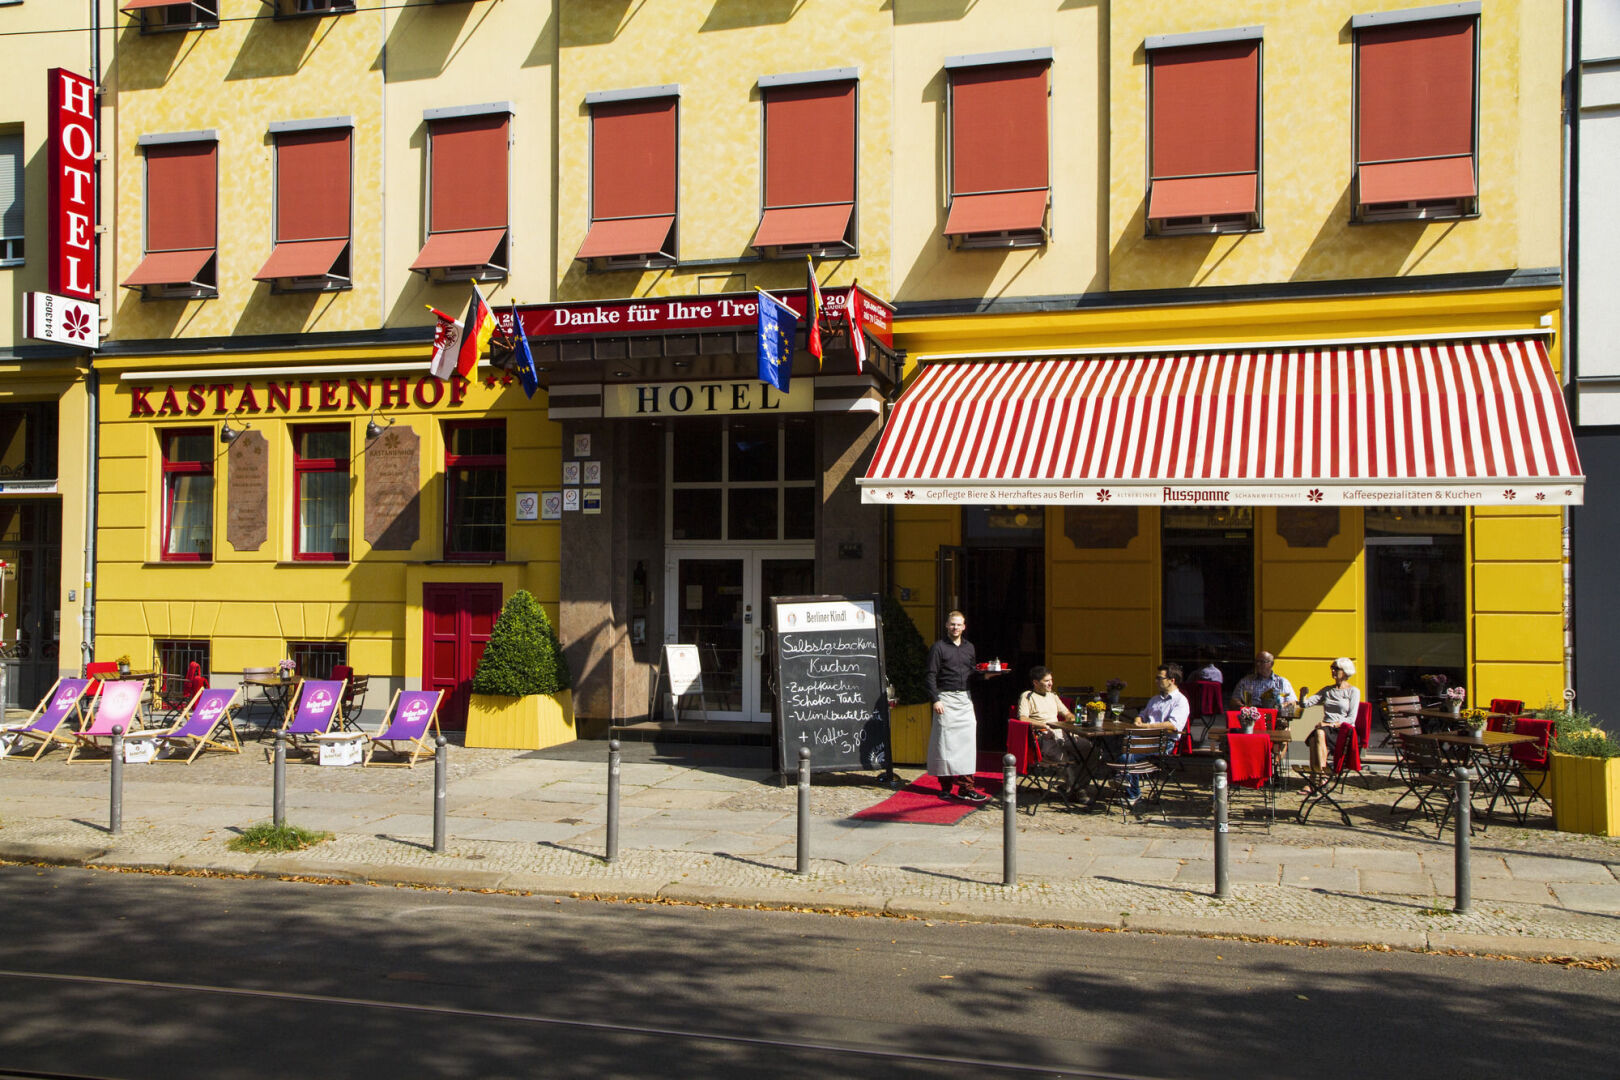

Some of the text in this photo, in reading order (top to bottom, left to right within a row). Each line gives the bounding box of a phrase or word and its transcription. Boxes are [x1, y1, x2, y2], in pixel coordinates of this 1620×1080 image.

[61, 74, 93, 294] HOTEL
[826, 295, 845, 305] 20
[554, 306, 620, 326] Danke
[627, 304, 660, 323] für
[666, 302, 712, 320] Ihre
[130, 376, 470, 417] KASTANIENHOF
[636, 383, 781, 413] HOTEL
[926, 490, 966, 501] Gepflegte
[967, 490, 988, 499] Biere
[990, 490, 996, 499] &
[998, 490, 1042, 499] Herzhaftes
[1059, 490, 1084, 499] Berlin
[1342, 490, 1482, 501] Kaffeespezialitäten & Kuchen
[806, 610, 847, 624] Berliner Kindl
[809, 657, 860, 673] Kuchen
[813, 727, 848, 746] Kaffee
